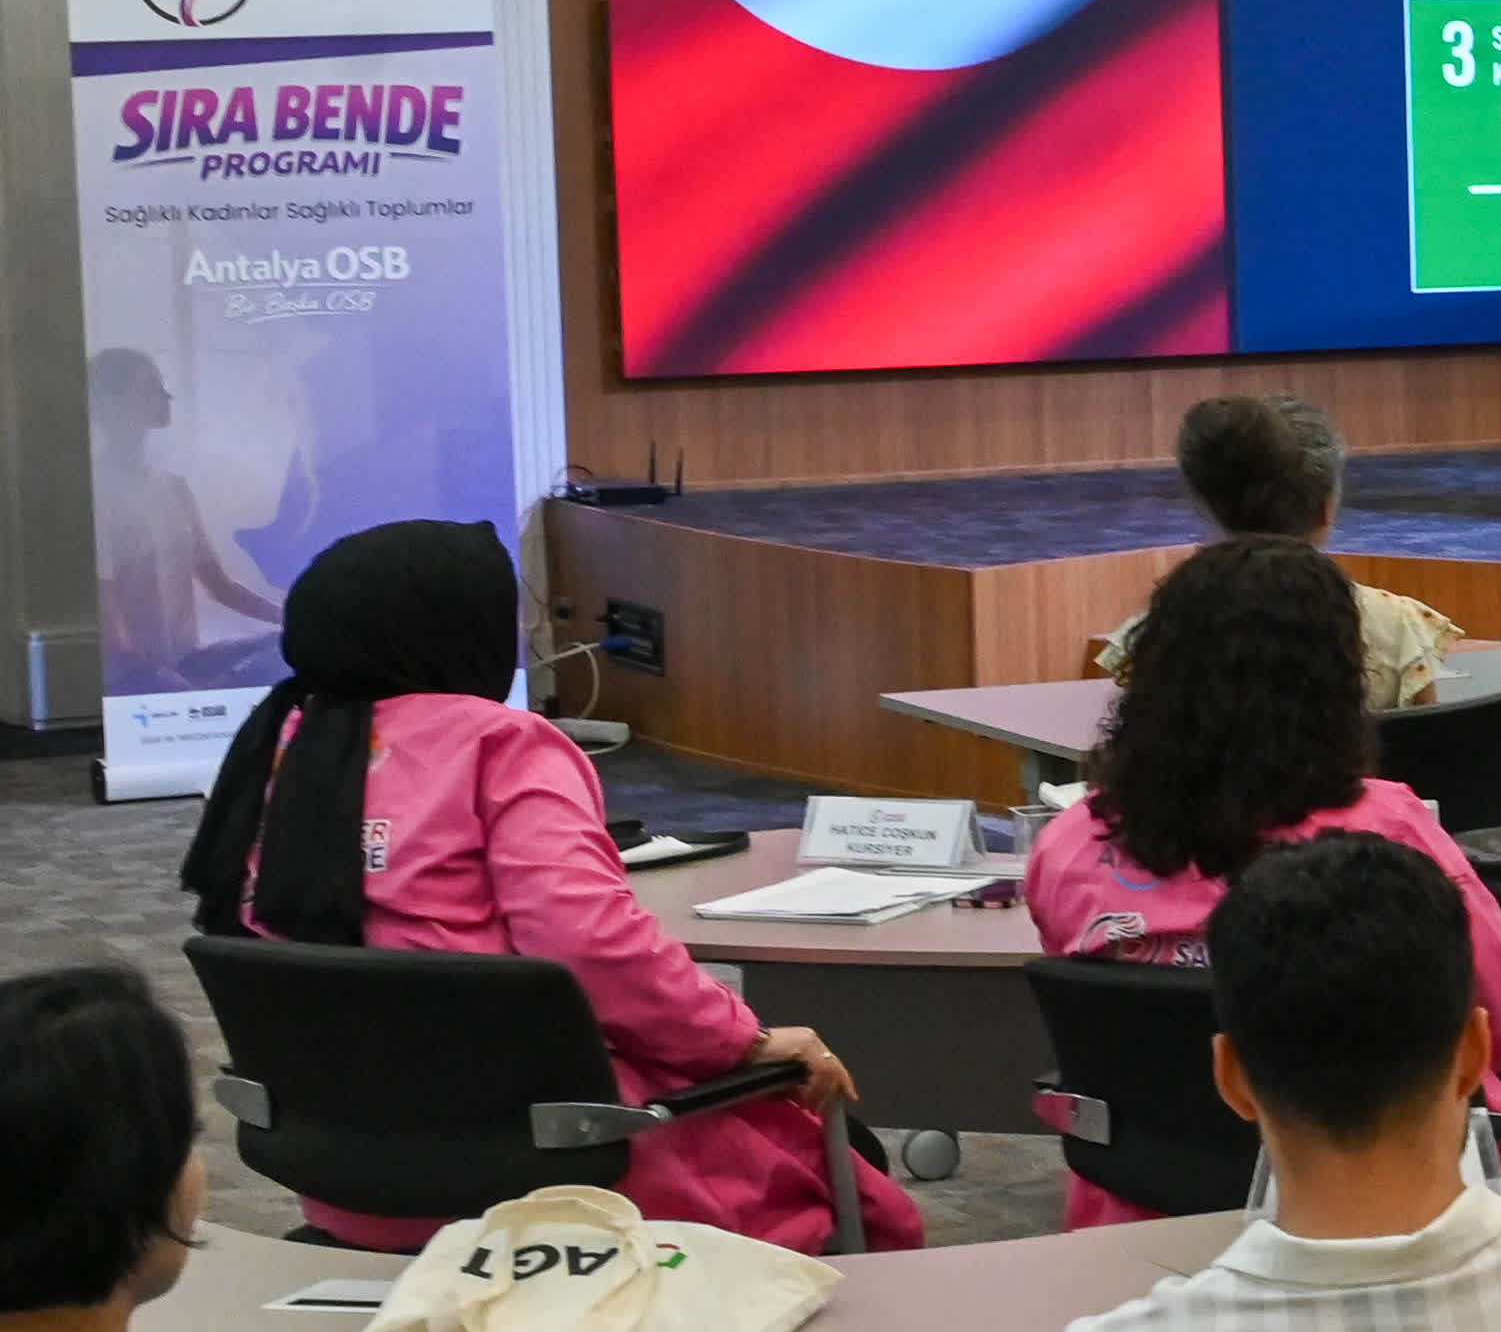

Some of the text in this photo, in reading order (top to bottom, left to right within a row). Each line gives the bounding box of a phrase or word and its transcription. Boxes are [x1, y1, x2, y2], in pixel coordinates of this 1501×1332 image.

[1442, 19, 1475, 88] 3
[112, 84, 464, 163] SIRA BENDE
[200, 151, 380, 182] PROGRAMI
[105, 198, 473, 229] Sağlıklı Kadınlar Sağlıklı Toplumlar
[183, 245, 411, 288] Antalya OSB
[460, 1243, 619, 1282] AGT
